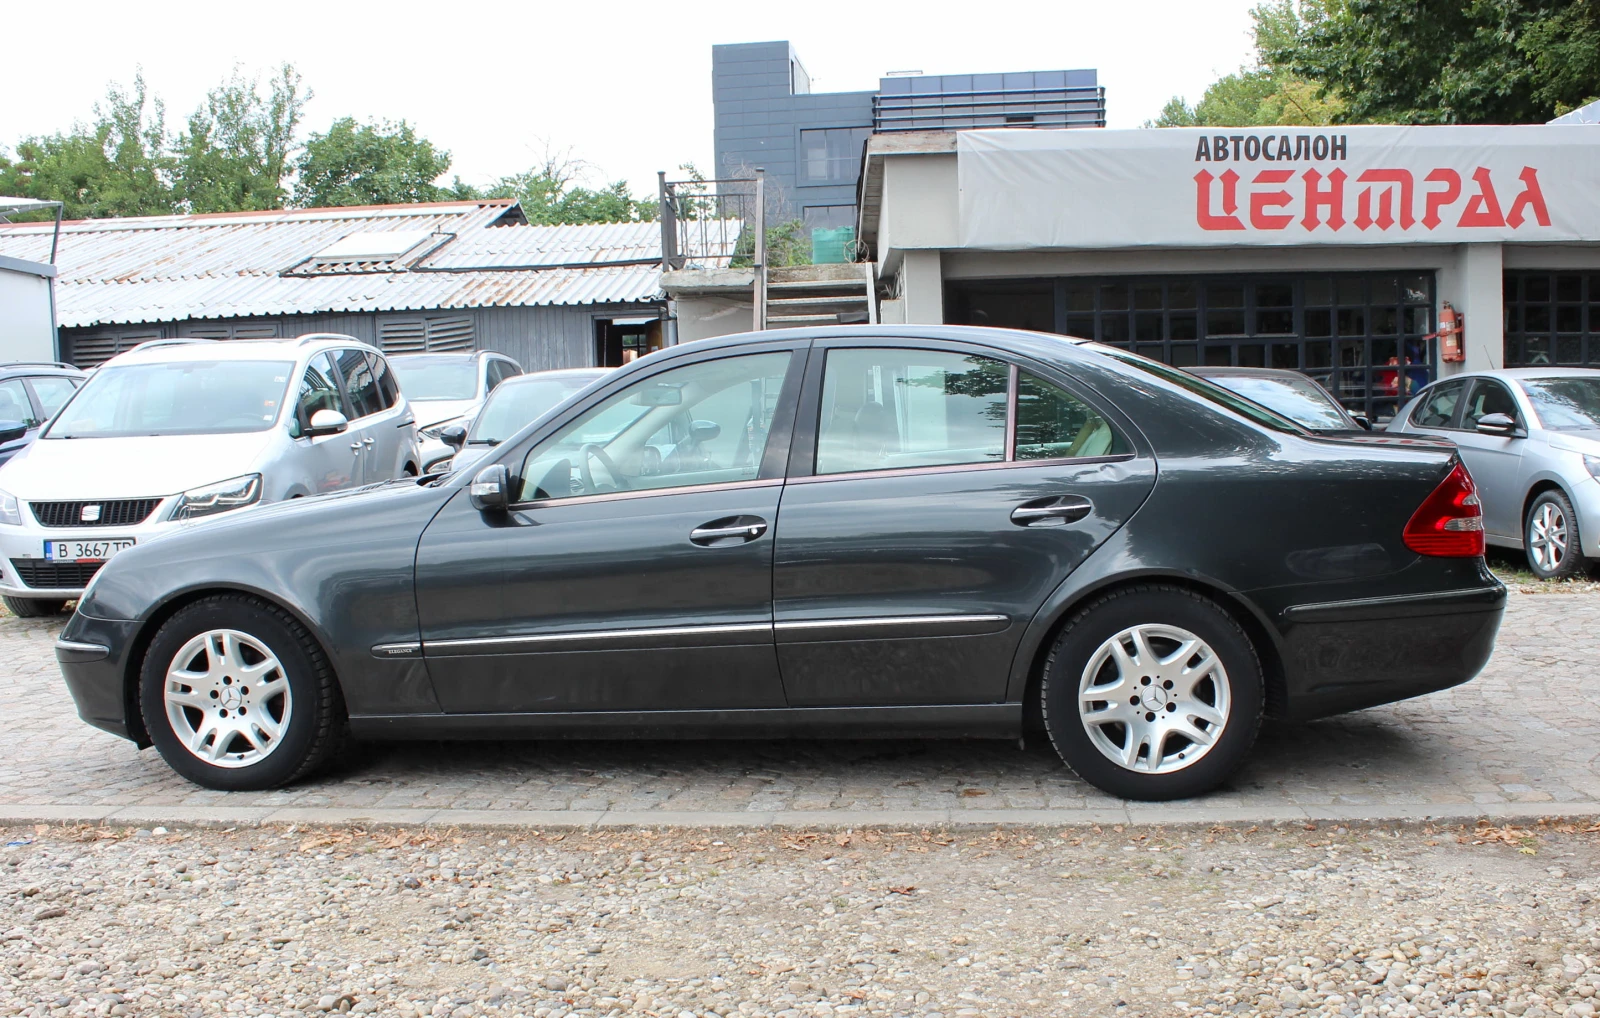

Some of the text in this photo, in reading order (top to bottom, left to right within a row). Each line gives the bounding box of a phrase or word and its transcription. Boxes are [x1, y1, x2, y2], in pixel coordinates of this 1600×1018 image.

[1195, 135, 1347, 162] АВТОСАЛОН
[1193, 166, 1552, 231] ЦЕНТРАЛ
[59, 543, 68, 558] B
[75, 542, 110, 557] 3667
